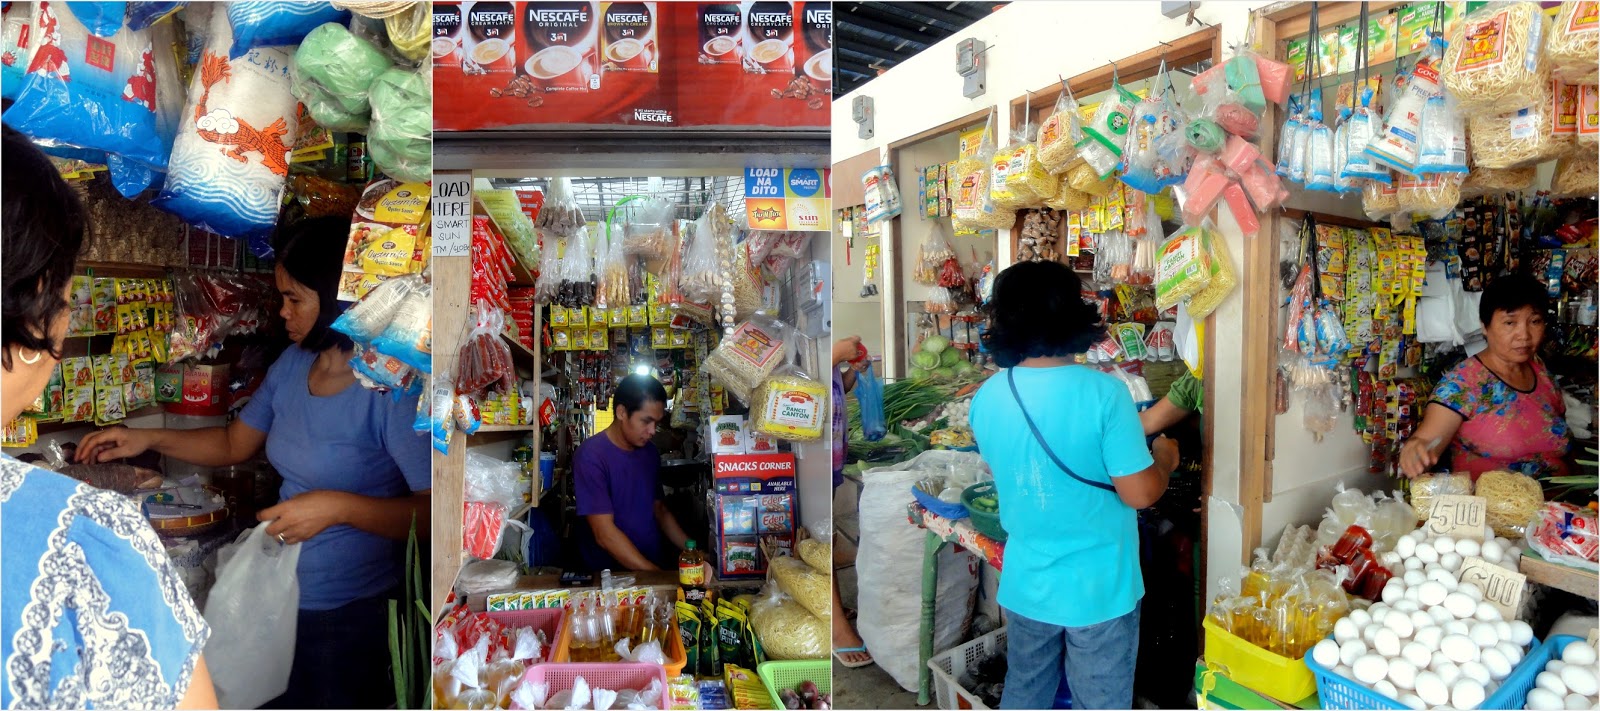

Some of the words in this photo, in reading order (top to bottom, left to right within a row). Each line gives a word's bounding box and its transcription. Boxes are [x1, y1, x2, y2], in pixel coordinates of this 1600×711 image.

[433, 11, 460, 22] ESCAFÉ
[750, 168, 778, 177] LOAD
[752, 186, 777, 194] DITO
[433, 202, 470, 216] HERE
[436, 220, 469, 229] SMART
[438, 232, 460, 240] SUN
[782, 411, 809, 419] CANTON
[718, 461, 758, 472] SNACKS
[759, 461, 792, 470] CORNER
[763, 514, 784, 525] Eden
